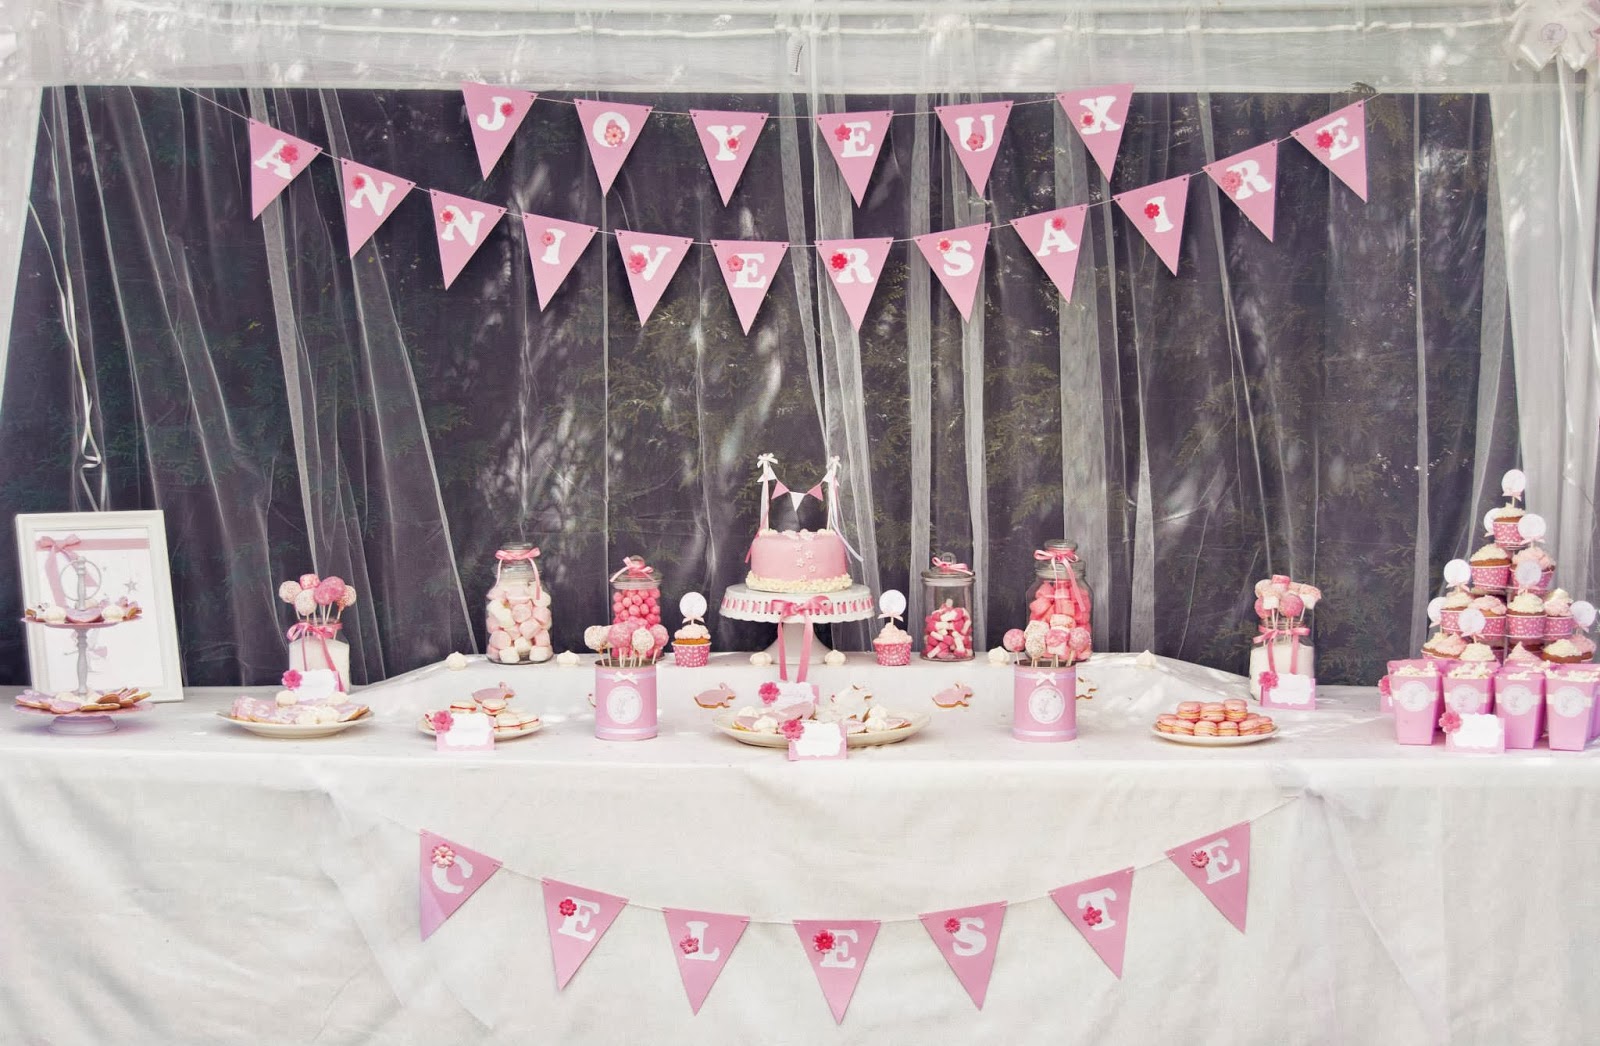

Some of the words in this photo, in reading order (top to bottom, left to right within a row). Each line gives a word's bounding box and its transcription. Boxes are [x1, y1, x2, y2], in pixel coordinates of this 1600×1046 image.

[477, 95, 1121, 161] JOYEUX
[254, 116, 1360, 289] ANNIVERSAIRE
[431, 835, 1242, 970] CELESTE
